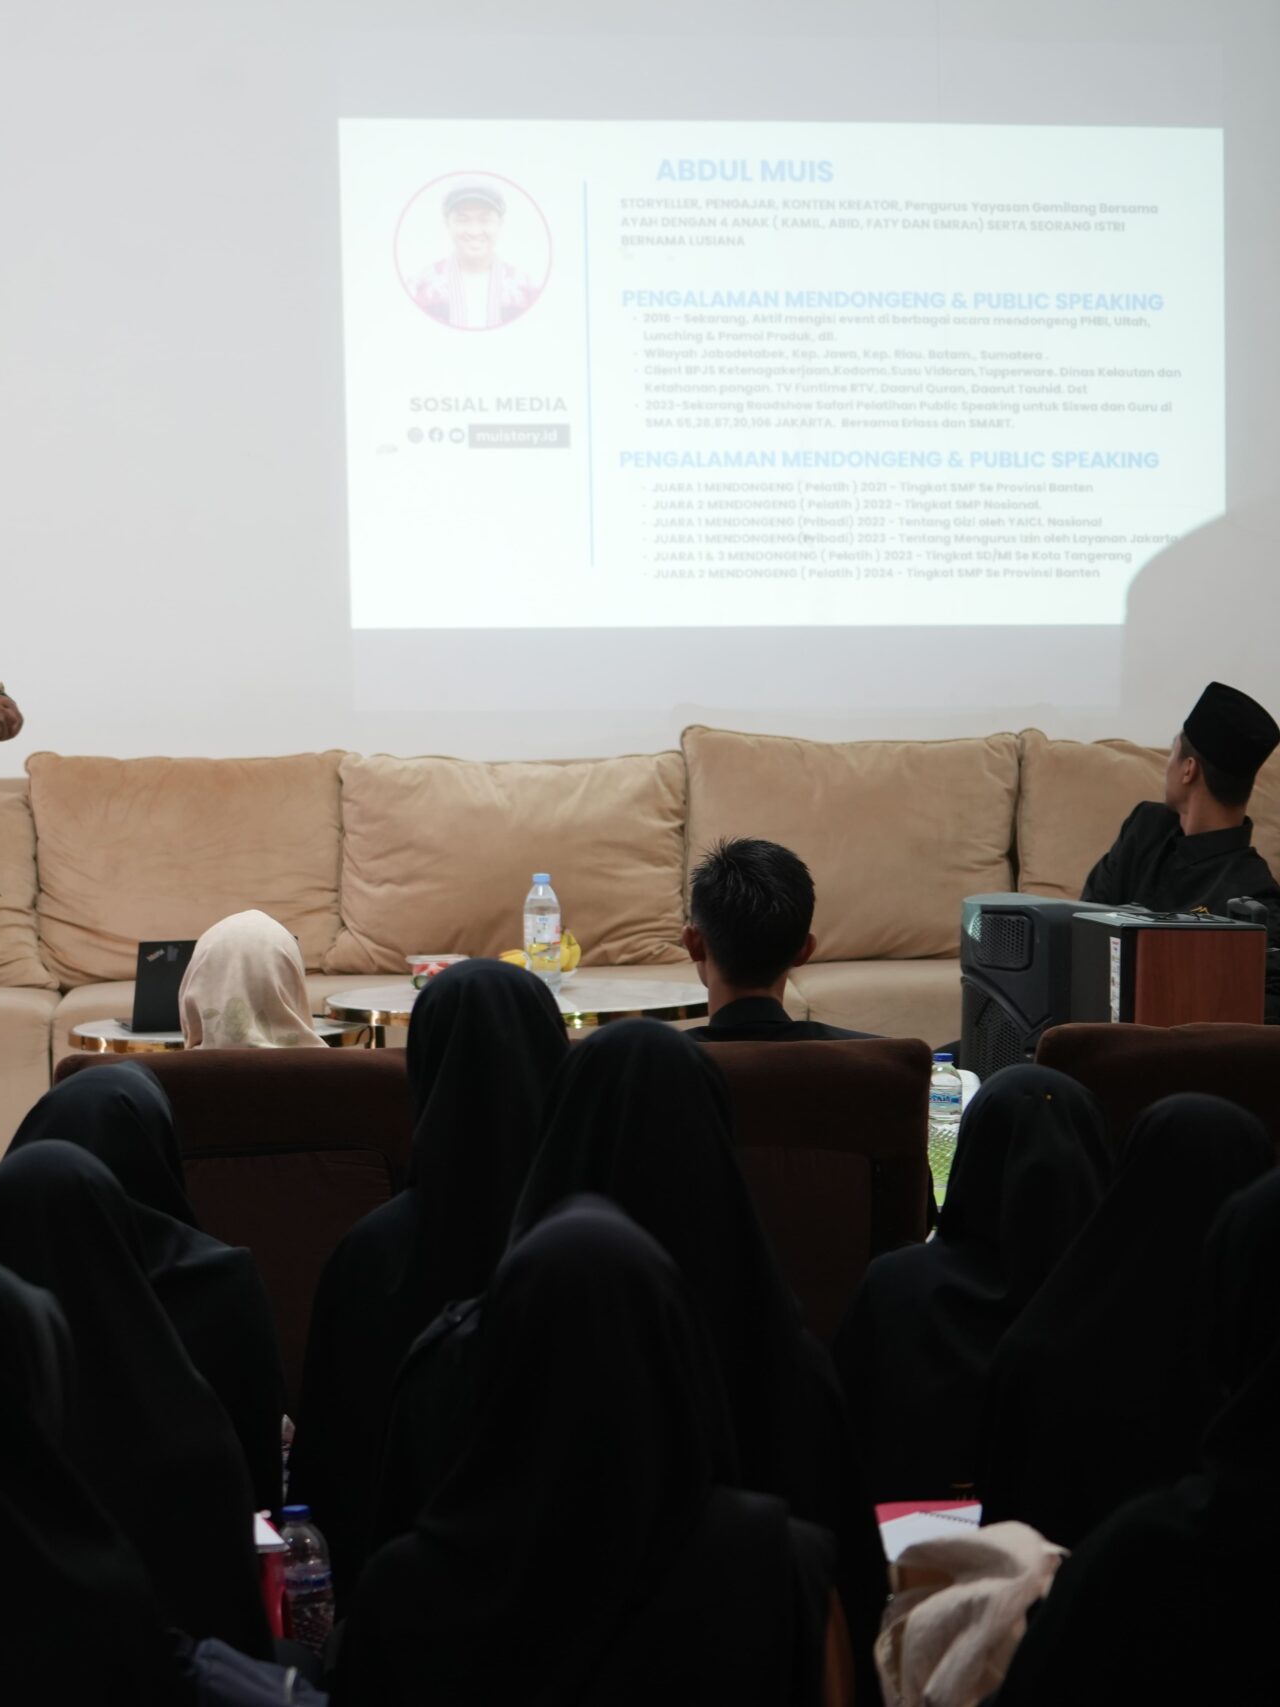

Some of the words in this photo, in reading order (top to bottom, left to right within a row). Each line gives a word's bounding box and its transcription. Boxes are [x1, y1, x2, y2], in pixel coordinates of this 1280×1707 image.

[656, 159, 752, 182] ABDUL
[759, 159, 834, 183] MUIS
[782, 198, 836, 210] KONTEN
[904, 201, 968, 214] Pengurus
[972, 203, 1030, 215] Yayasan
[1098, 204, 1159, 214] Bersama
[621, 216, 658, 227] AYAH
[661, 216, 717, 228] DENGAN
[732, 217, 770, 228] ANAK
[866, 217, 898, 229] FATY
[901, 218, 931, 230] DAN
[987, 220, 1027, 231] SERTA
[1030, 220, 1092, 232] SEORANG
[1094, 221, 1125, 232] ISTRI
[620, 235, 685, 246] BERNAMA
[689, 235, 745, 246] LUSIANA
[622, 290, 778, 308] PENGALAMAN
[785, 290, 945, 309] MENDONGENG
[973, 292, 1050, 310] PUBLIC
[1055, 293, 1164, 311] SPEAKING
[752, 312, 783, 324] Aktif
[784, 312, 837, 327] mengisi
[838, 312, 876, 324] event
[877, 312, 890, 325] di
[891, 313, 951, 328] berbagai
[952, 313, 991, 326] acara
[993, 317, 1079, 330] mendongeng
[643, 331, 703, 344] Lunching
[644, 348, 697, 361] Wilayah
[980, 351, 1043, 360] Sumatera
[644, 365, 682, 376] Client
[1059, 367, 1095, 378] Dinas
[1097, 368, 1155, 378] Kelautan
[1157, 369, 1182, 378] dan
[644, 384, 716, 393] Ketahanan
[777, 382, 792, 393] TV
[795, 383, 848, 393] Funtime
[880, 383, 924, 394] Daarul
[971, 384, 1015, 394] Daarut
[1067, 384, 1088, 395] Dst
[410, 396, 488, 413] SOSIAL
[495, 396, 566, 412] MEDIA
[746, 401, 813, 411] Roadshow
[815, 400, 854, 411] Safari
[856, 400, 917, 411] Pelatihan
[919, 400, 958, 411] Public
[961, 402, 1020, 415] Speaking
[1022, 402, 1059, 412] untuk
[1062, 402, 1098, 412] Siswa
[1100, 403, 1125, 412] dan
[1127, 402, 1158, 412] Guru
[1160, 401, 1173, 413] di
[645, 417, 673, 428] SMA
[841, 419, 899, 428] Bersama
[941, 419, 966, 429] dan
[476, 428, 558, 445] muistory.id
[619, 451, 776, 468] PENGALAMAN
[782, 451, 942, 468] MENDONGENG
[970, 451, 1045, 468] PUBLIC
[1051, 451, 1159, 469] SPEAKING
[652, 482, 694, 493] JUARA
[704, 482, 795, 493] MENDONGENG
[804, 482, 850, 492] Pelatih
[860, 481, 887, 492] 2021
[899, 482, 948, 496] Tingkat
[949, 482, 976, 493] SMP
[978, 482, 994, 493] Se
[995, 482, 1047, 493] Provinsi
[1048, 483, 1094, 493] Banten
[653, 500, 694, 510] JUARA
[707, 499, 797, 510] MENDONGENG
[807, 499, 852, 510] Pelatih
[863, 498, 892, 510] 2022
[905, 499, 953, 513] Tingkat
[955, 499, 981, 510] SMP
[654, 517, 694, 528] JUARA
[704, 517, 795, 527] MENDONGENG
[857, 516, 886, 527] 2022
[898, 518, 951, 530] Tentang
[953, 516, 976, 528] Gizi
[979, 518, 1005, 527] oleh
[1047, 518, 1103, 527] Nasional
[654, 534, 694, 545] JUARA
[704, 533, 794, 544] MENDONGENG
[857, 532, 886, 544] 2023
[899, 534, 952, 547] Tentang
[953, 534, 1018, 546] Mengurus
[1043, 534, 1071, 543] oleh
[1072, 534, 1127, 546] Layanan
[654, 551, 695, 562] JUARA
[728, 550, 817, 561] MENDONGENG
[828, 550, 873, 561] Pelatih
[884, 550, 913, 561] 2023
[926, 551, 973, 564] Tingkat
[1014, 551, 1029, 561] Se
[1031, 551, 1061, 561] Kota
[1064, 552, 1132, 564] Tangerang
[654, 569, 695, 579] JUARA
[708, 568, 798, 579] MENDONGENG
[808, 568, 853, 578] Pelatih
[863, 568, 894, 578] 2024
[907, 568, 954, 582] Tingkat
[956, 568, 983, 578] SMP
[985, 568, 1001, 578] Se
[1002, 568, 1053, 578] Provinsi
[1054, 568, 1100, 578] Banten
